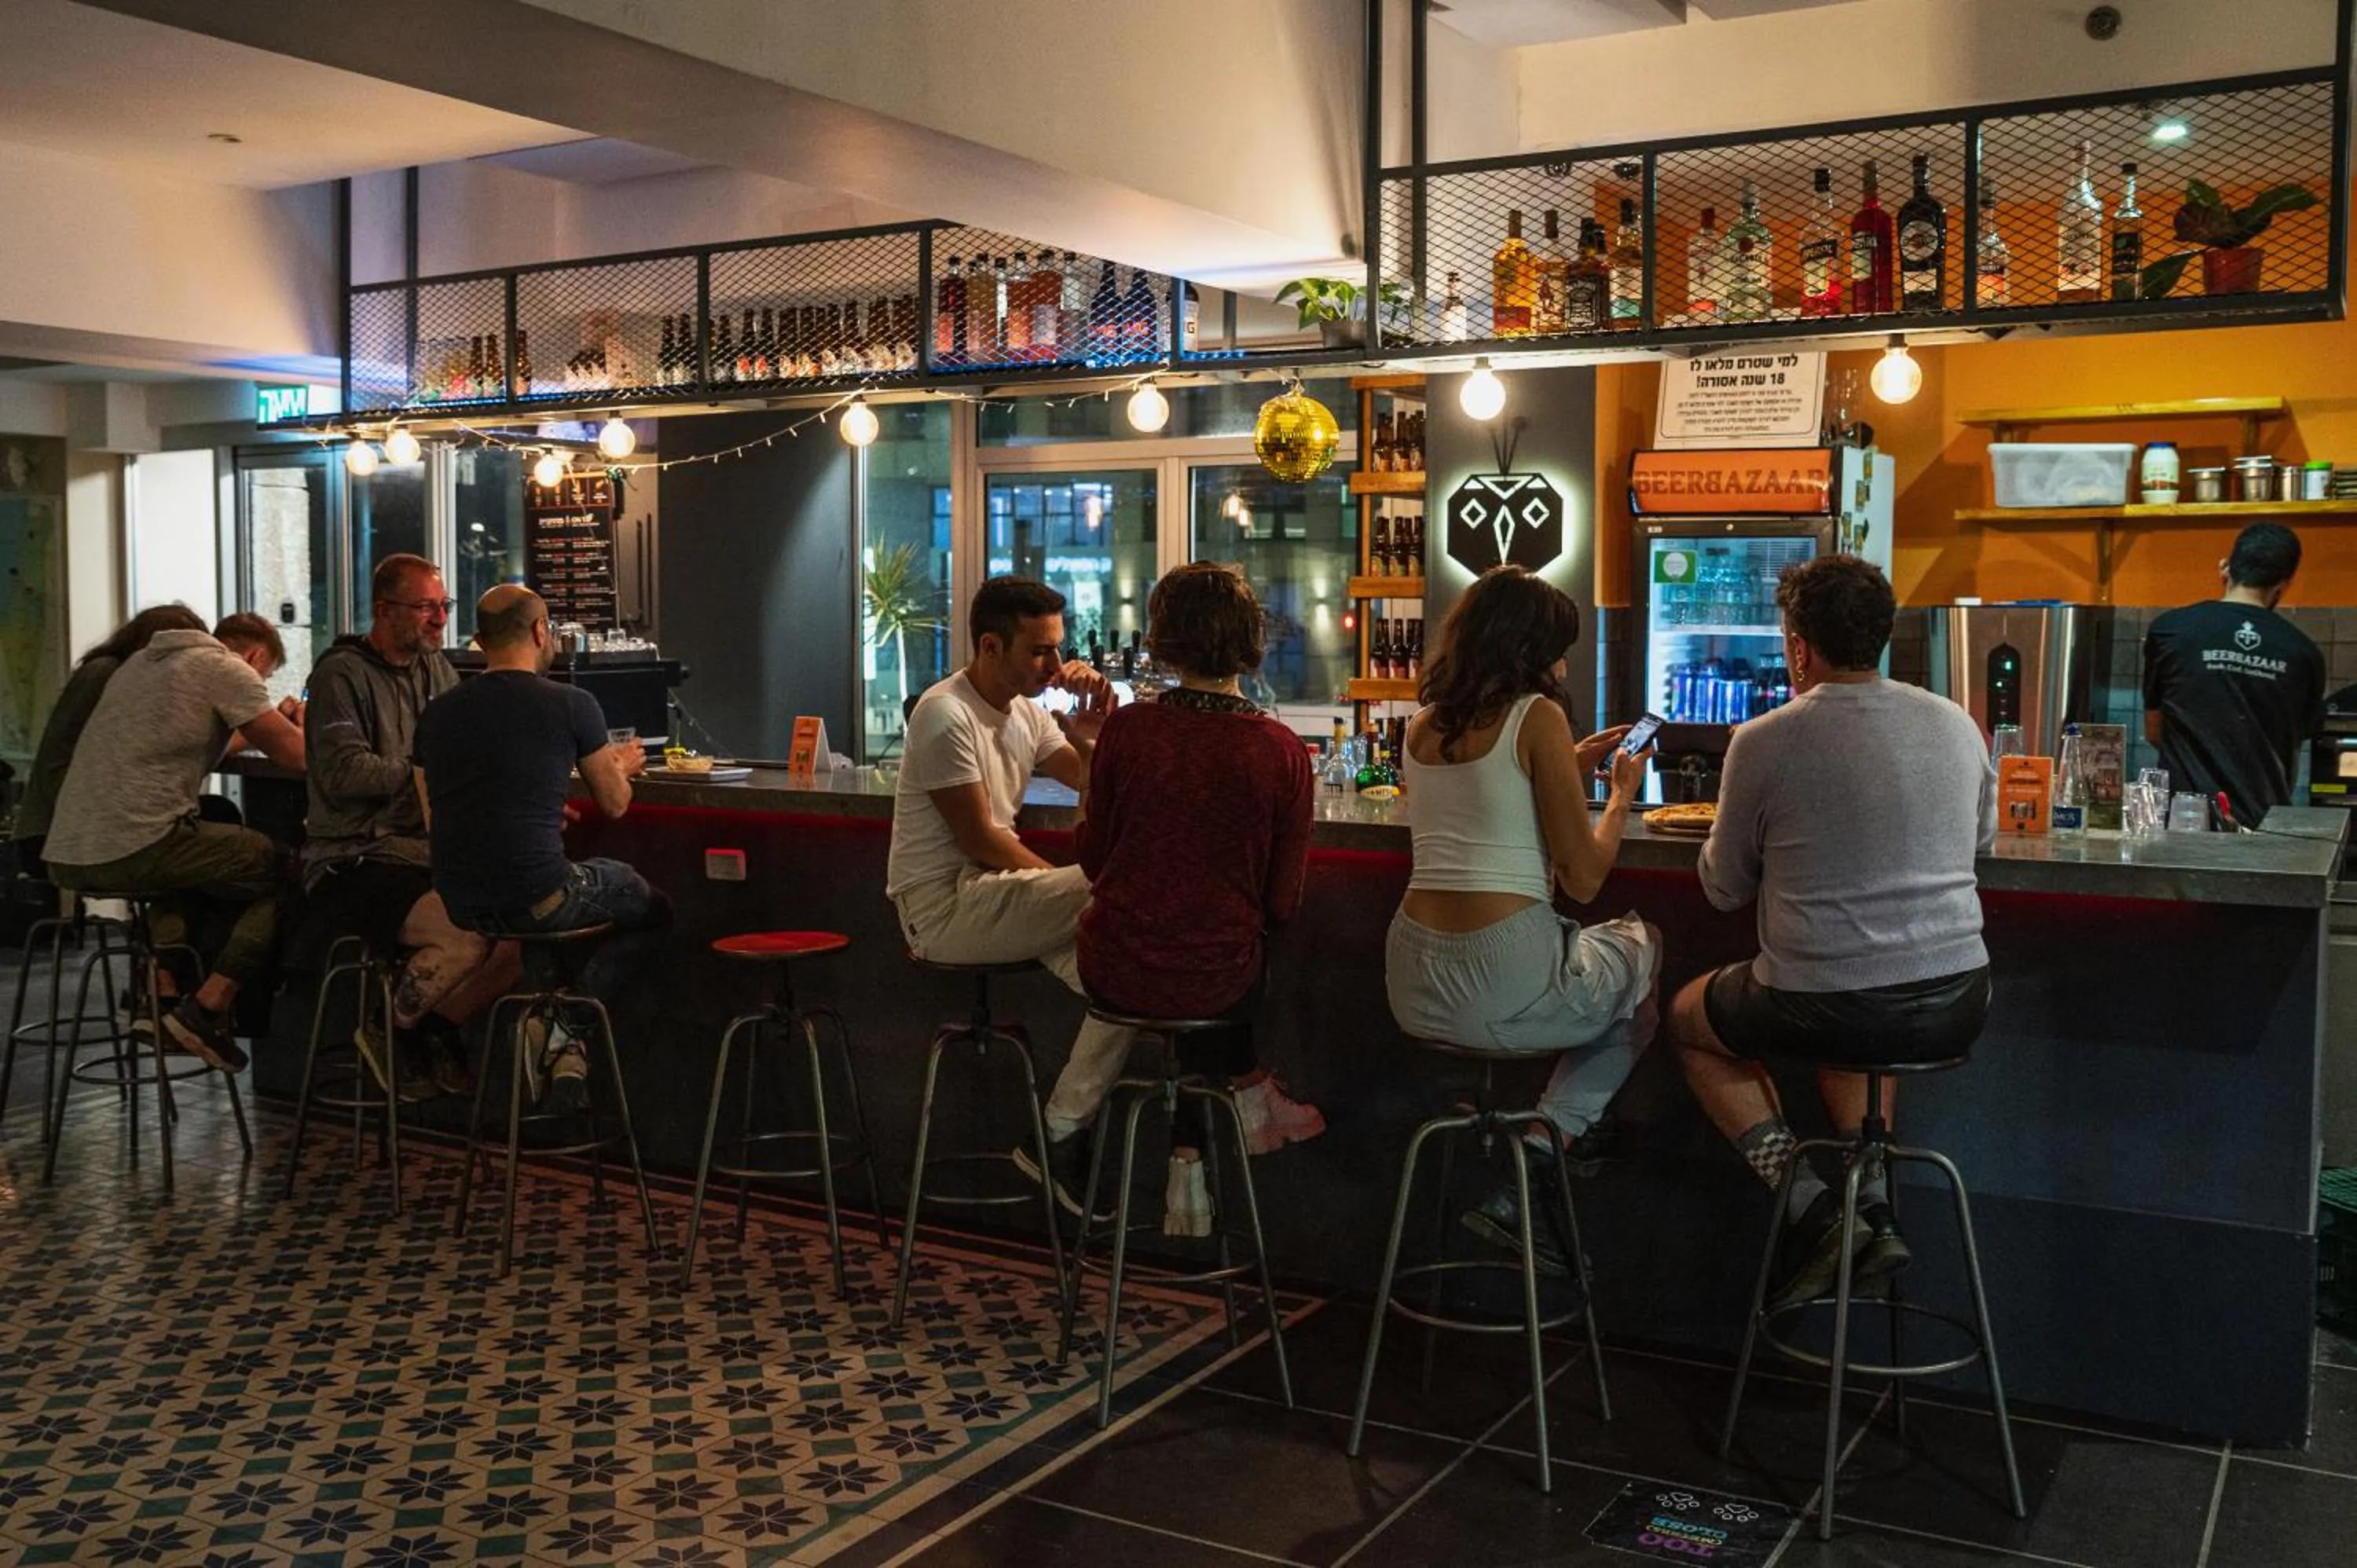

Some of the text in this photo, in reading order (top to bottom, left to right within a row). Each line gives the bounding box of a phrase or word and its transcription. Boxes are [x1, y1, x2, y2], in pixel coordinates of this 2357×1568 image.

[1690, 355, 1798, 372] למי שטרם מלאו לו
[1696, 372, 1785, 388] 18 שנה אסורה!
[1636, 469, 1824, 495] BEERBAZAAR
[2201, 649, 2288, 674] BEERBAZAAR
